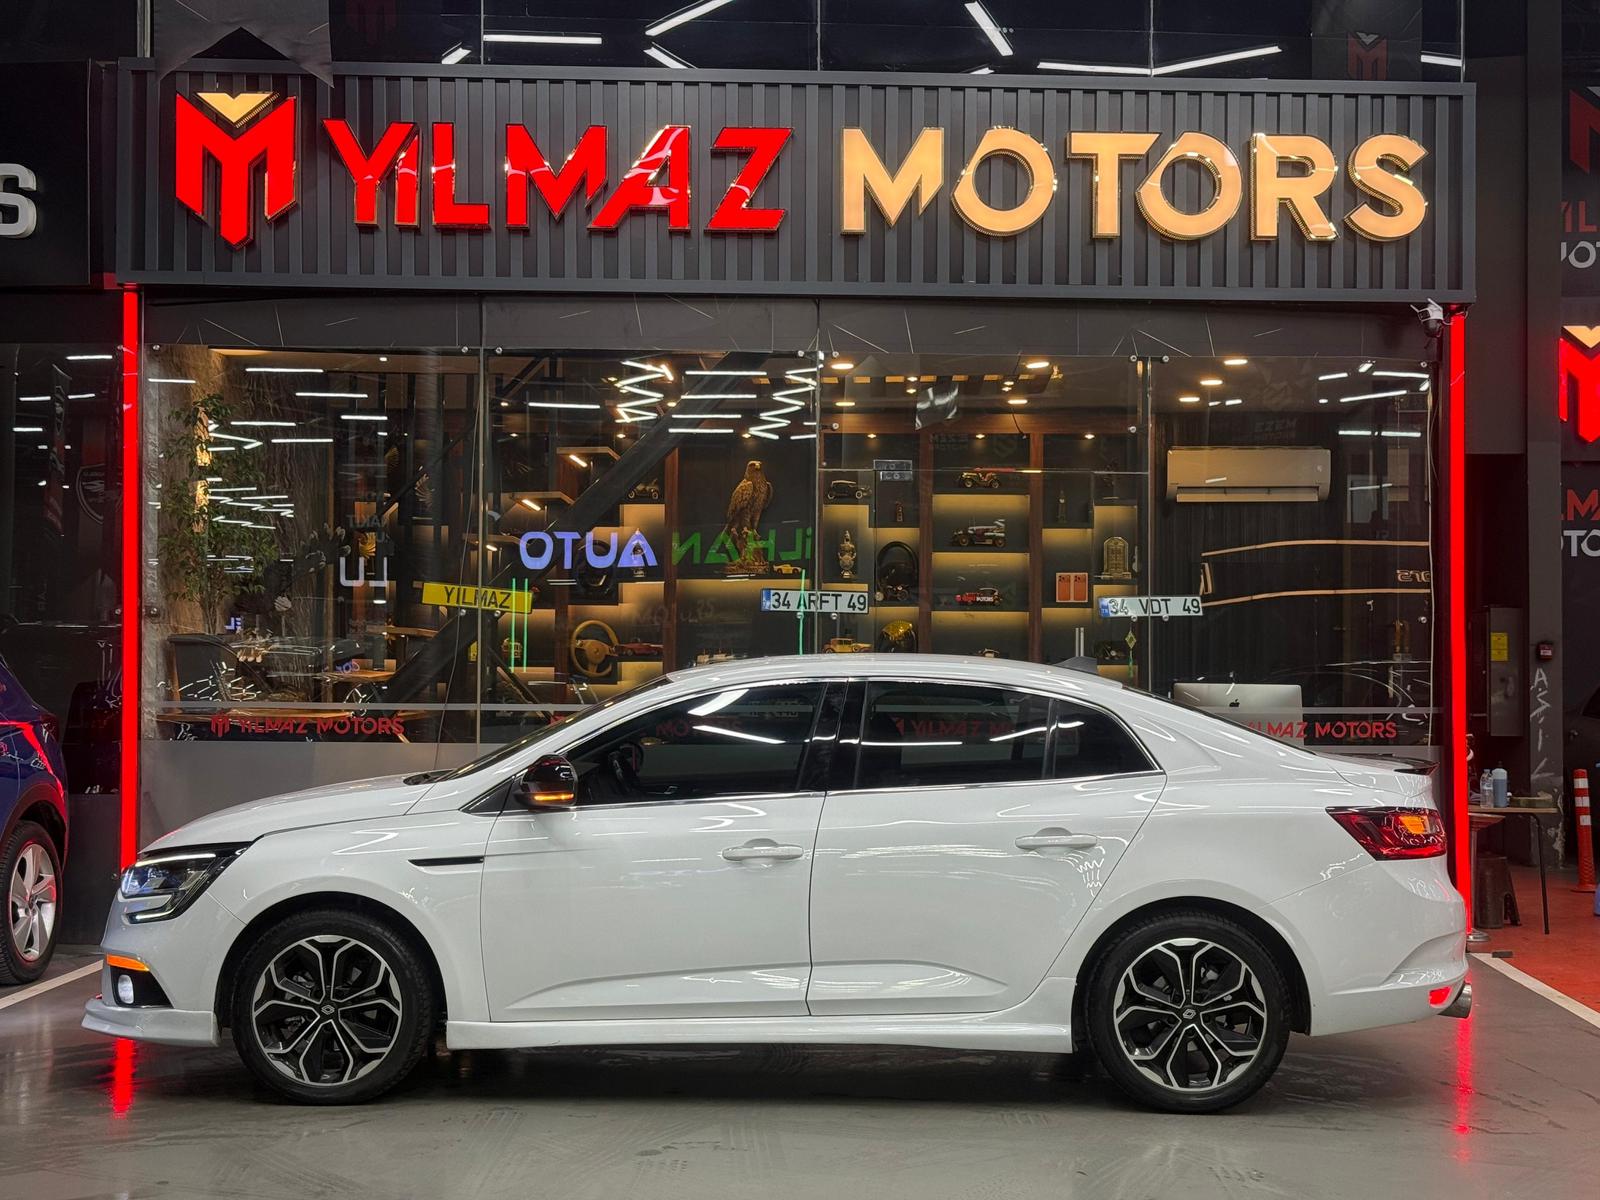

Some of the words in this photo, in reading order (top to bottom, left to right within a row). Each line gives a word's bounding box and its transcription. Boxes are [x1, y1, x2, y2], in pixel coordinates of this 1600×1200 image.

[322, 117, 794, 233] YILMAZ
[840, 126, 1428, 243] MOTORS
[444, 586, 513, 609] YILMAZ
[772, 592, 791, 609] 34
[847, 594, 867, 611] 49
[1108, 599, 1129, 615] 34
[1138, 599, 1171, 614] VDT
[1183, 599, 1200, 613] 49
[236, 716, 308, 735] YILMAZ
[316, 716, 404, 735] MOTORS
[1315, 721, 1397, 738] MOTORS
